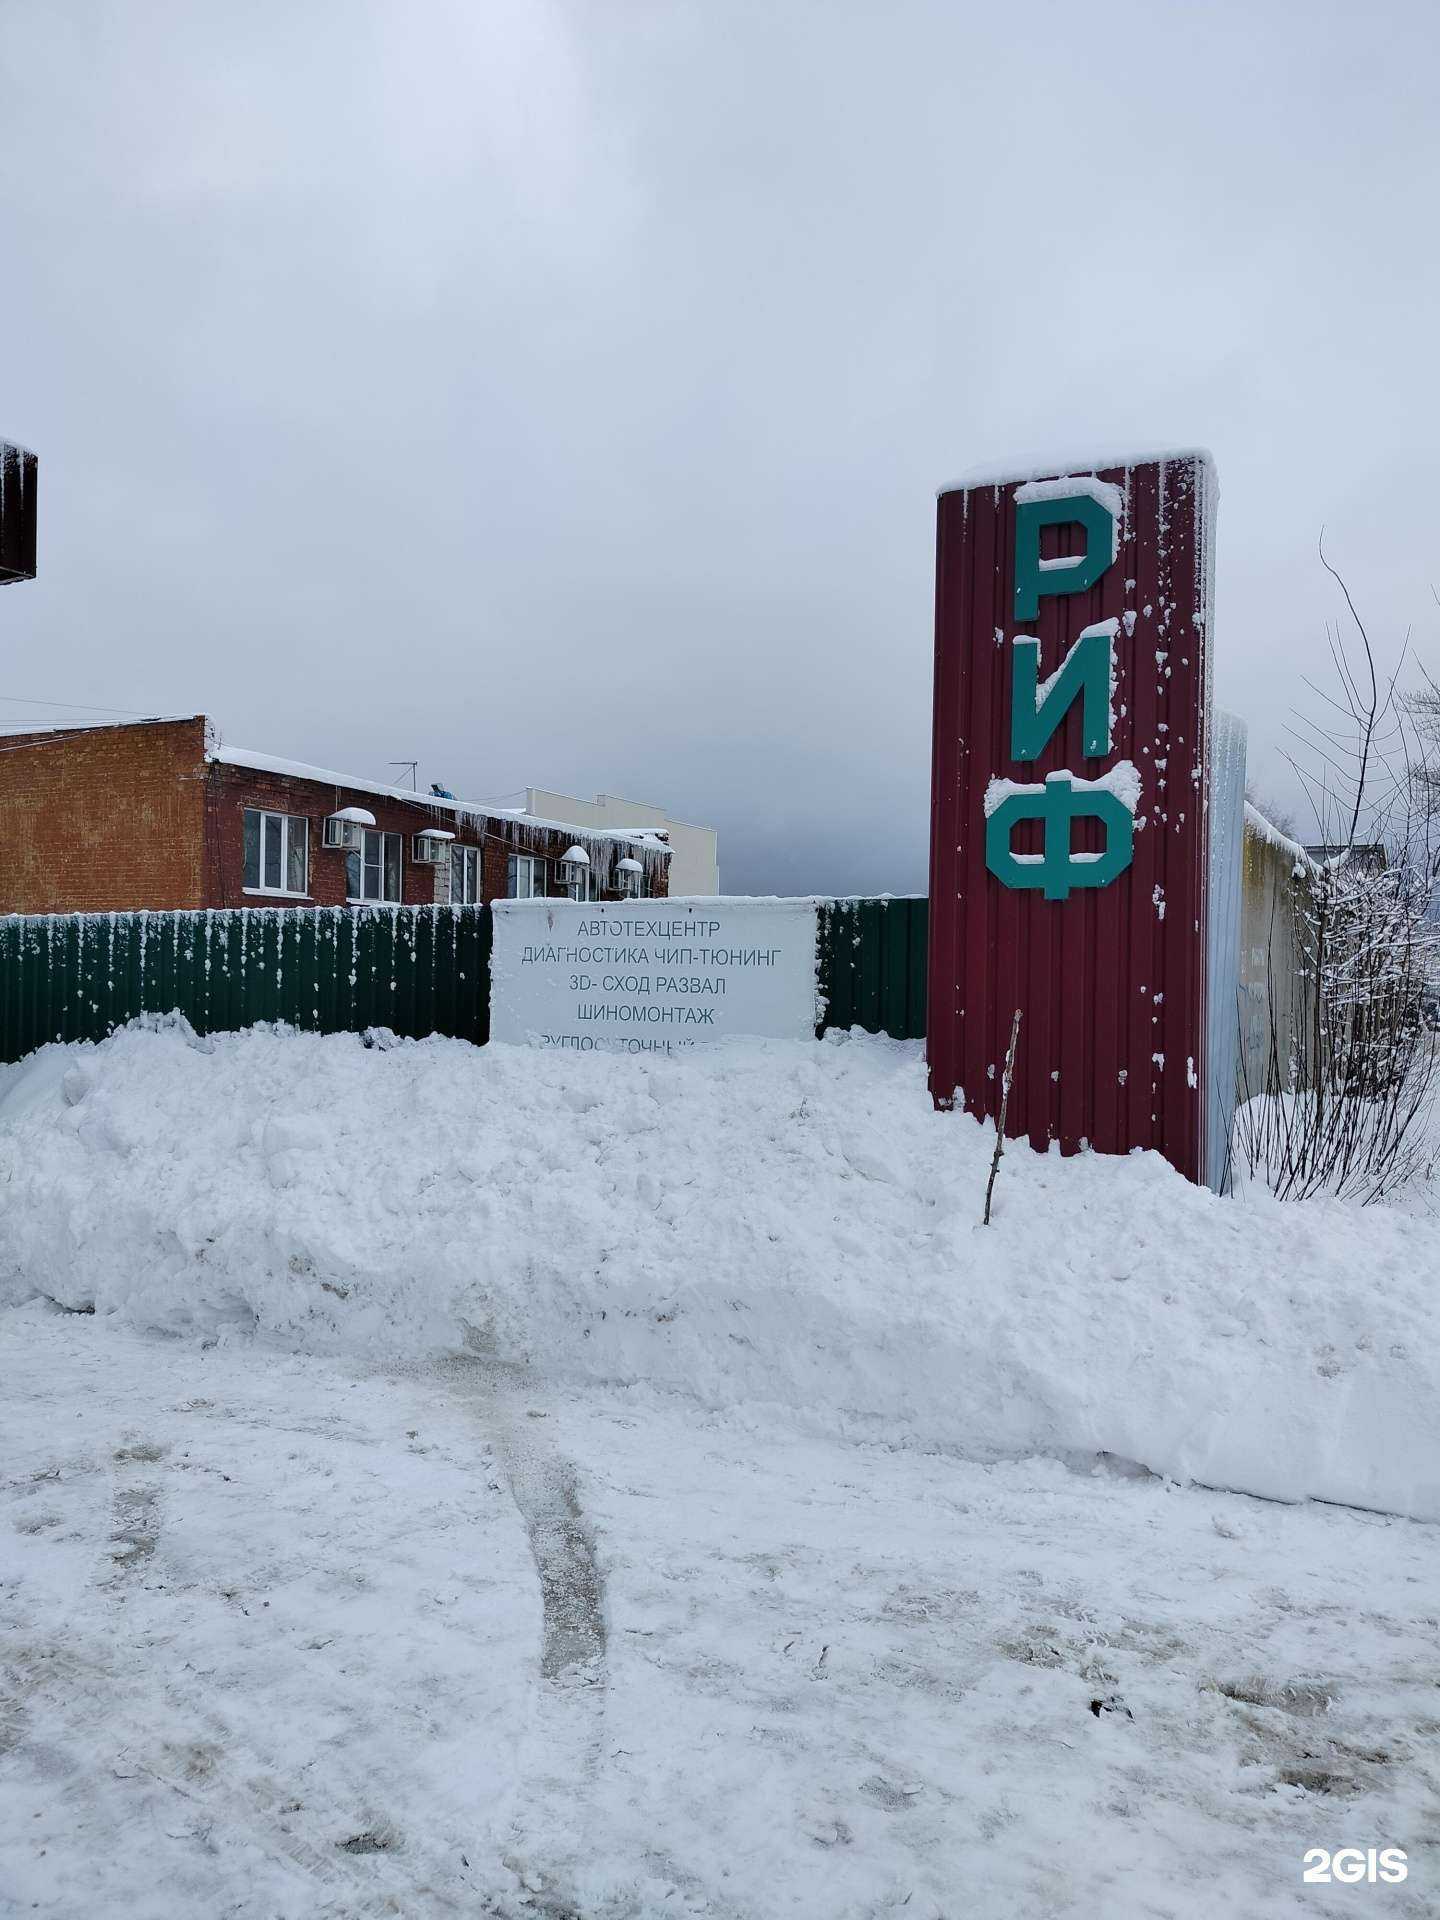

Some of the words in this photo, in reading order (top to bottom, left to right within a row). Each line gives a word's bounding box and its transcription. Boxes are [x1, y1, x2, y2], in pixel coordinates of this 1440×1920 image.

[985, 494, 1133, 900] РИФ
[577, 920, 721, 940] АВТОТЕХЦЕНТР
[521, 946, 649, 966] ДИАГНОСТИКА
[654, 948, 782, 967] ЧИП-ТЮНИНГ
[602, 975, 651, 995] СХОД
[656, 977, 726, 995] РАЗВАЛ
[577, 1004, 715, 1024] ШИНОМОНТАЖ
